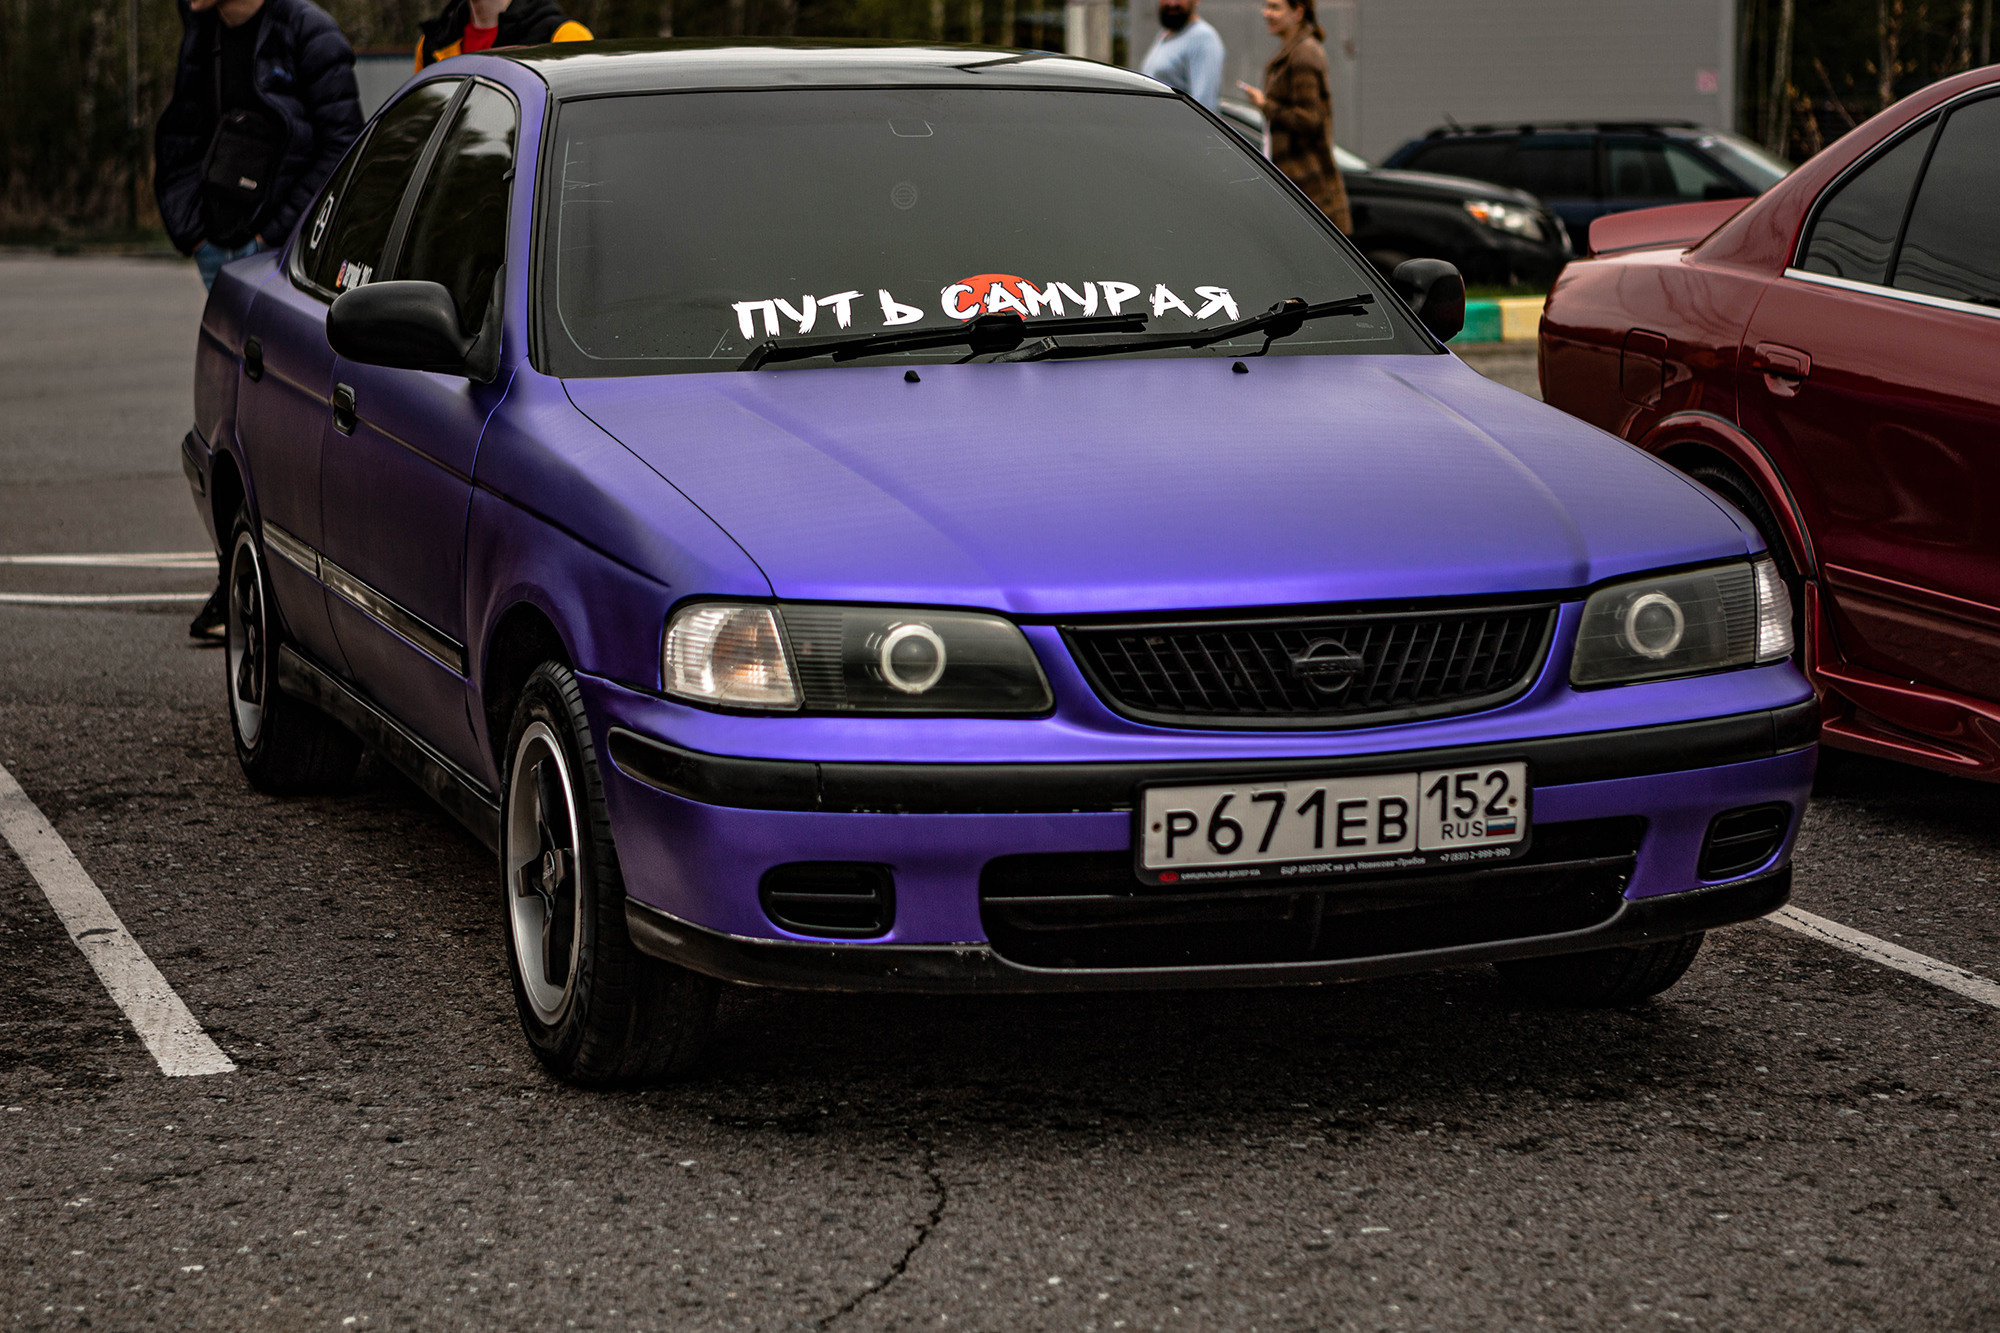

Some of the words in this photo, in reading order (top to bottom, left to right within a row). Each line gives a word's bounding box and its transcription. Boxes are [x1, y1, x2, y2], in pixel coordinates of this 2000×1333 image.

[731, 289, 925, 340] ПУТЬ
[940, 281, 1241, 321] САМУРАЯ
[1165, 787, 1409, 859] Р671ЕВ
[1425, 769, 1512, 822] 152
[1441, 819, 1485, 840] RUS
